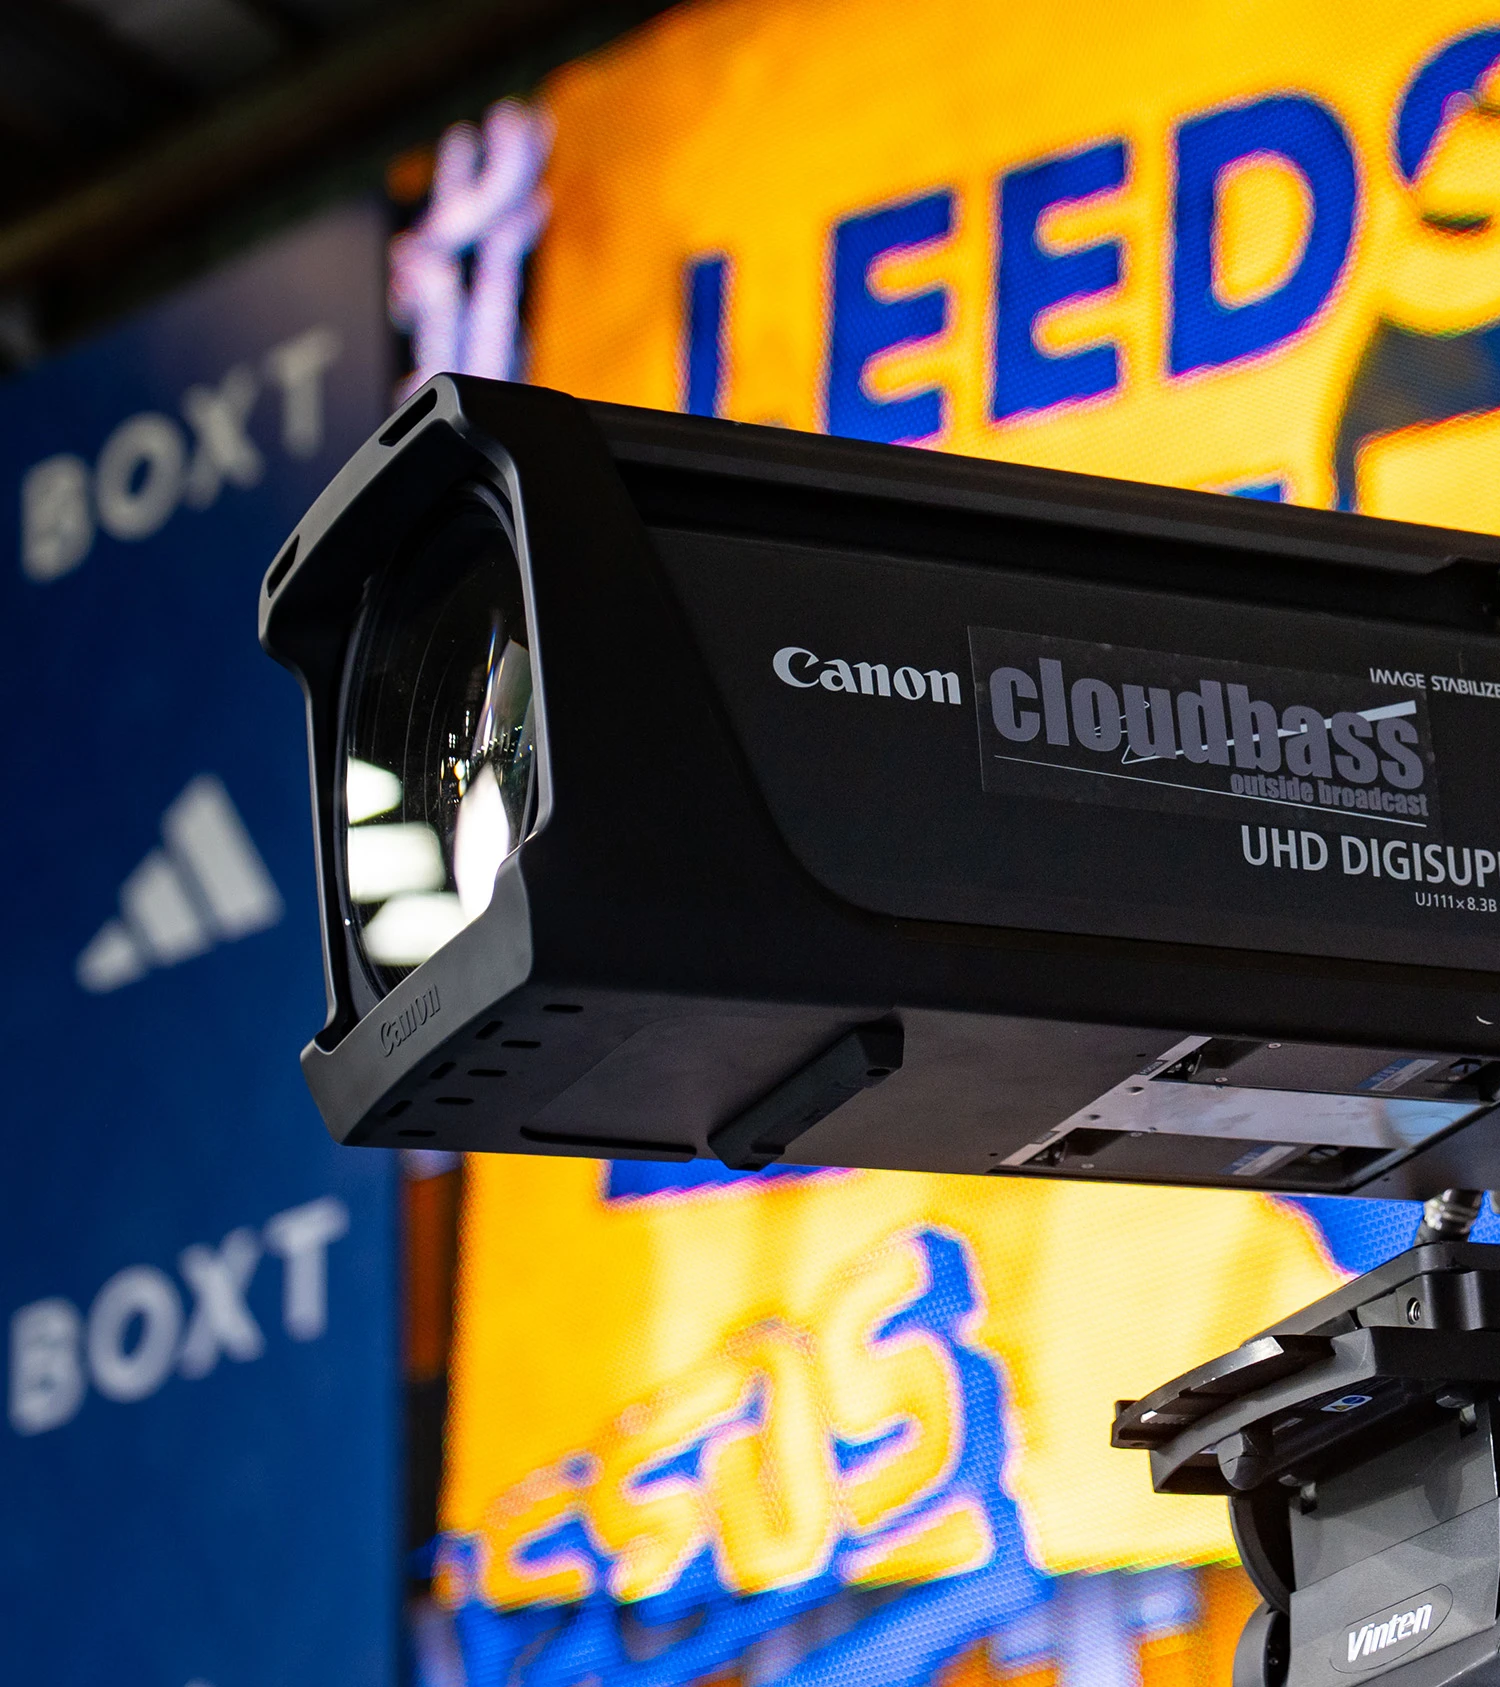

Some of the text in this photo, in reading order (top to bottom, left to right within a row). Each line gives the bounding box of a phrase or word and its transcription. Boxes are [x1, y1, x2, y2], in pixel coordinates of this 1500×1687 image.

[20, 328, 342, 582] BOXT
[772, 646, 961, 705] Canon
[1369, 667, 1427, 690] IMAGE
[988, 656, 1425, 790] cloudbass
[1229, 772, 1430, 818] outside broadcast
[1240, 825, 1329, 872] UHD
[380, 984, 441, 1058] Canon
[8, 1197, 350, 1438] BOXT
[1346, 1603, 1433, 1663] Vinten
